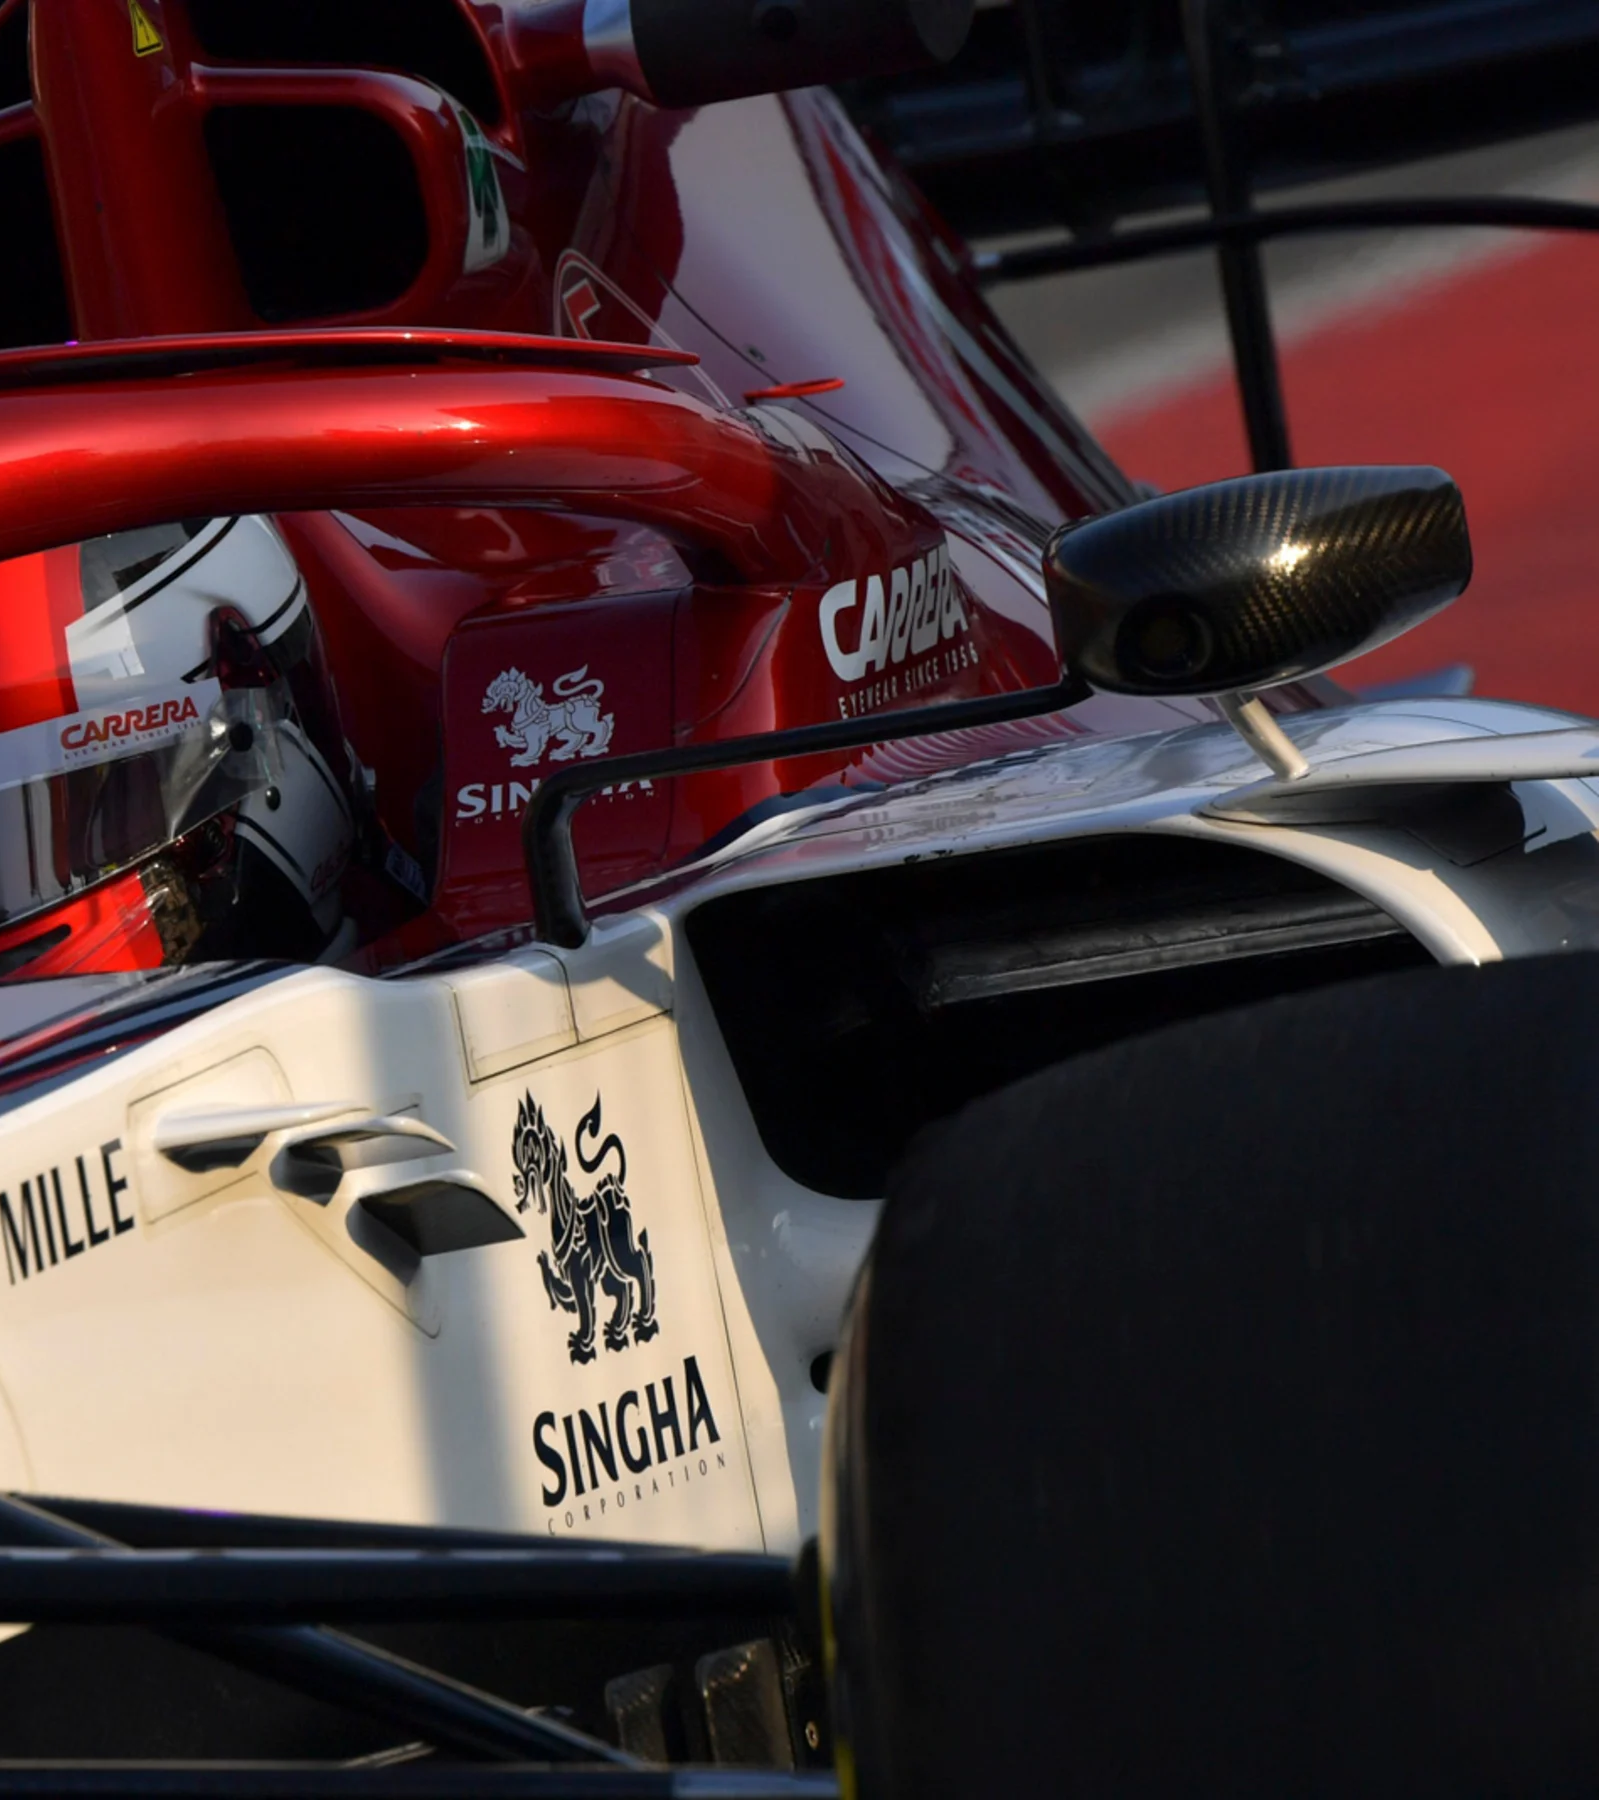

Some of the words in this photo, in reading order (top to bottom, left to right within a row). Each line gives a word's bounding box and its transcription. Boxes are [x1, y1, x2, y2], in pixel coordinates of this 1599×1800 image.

[819, 542, 968, 682] CARRERA
[838, 676, 898, 719] EYEWEAR
[905, 657, 939, 692] SINCE
[945, 641, 979, 675] 1956
[61, 696, 200, 750] CARRERA
[533, 1355, 721, 1507] SINGHA
[547, 1452, 726, 1537] CORPORATION
